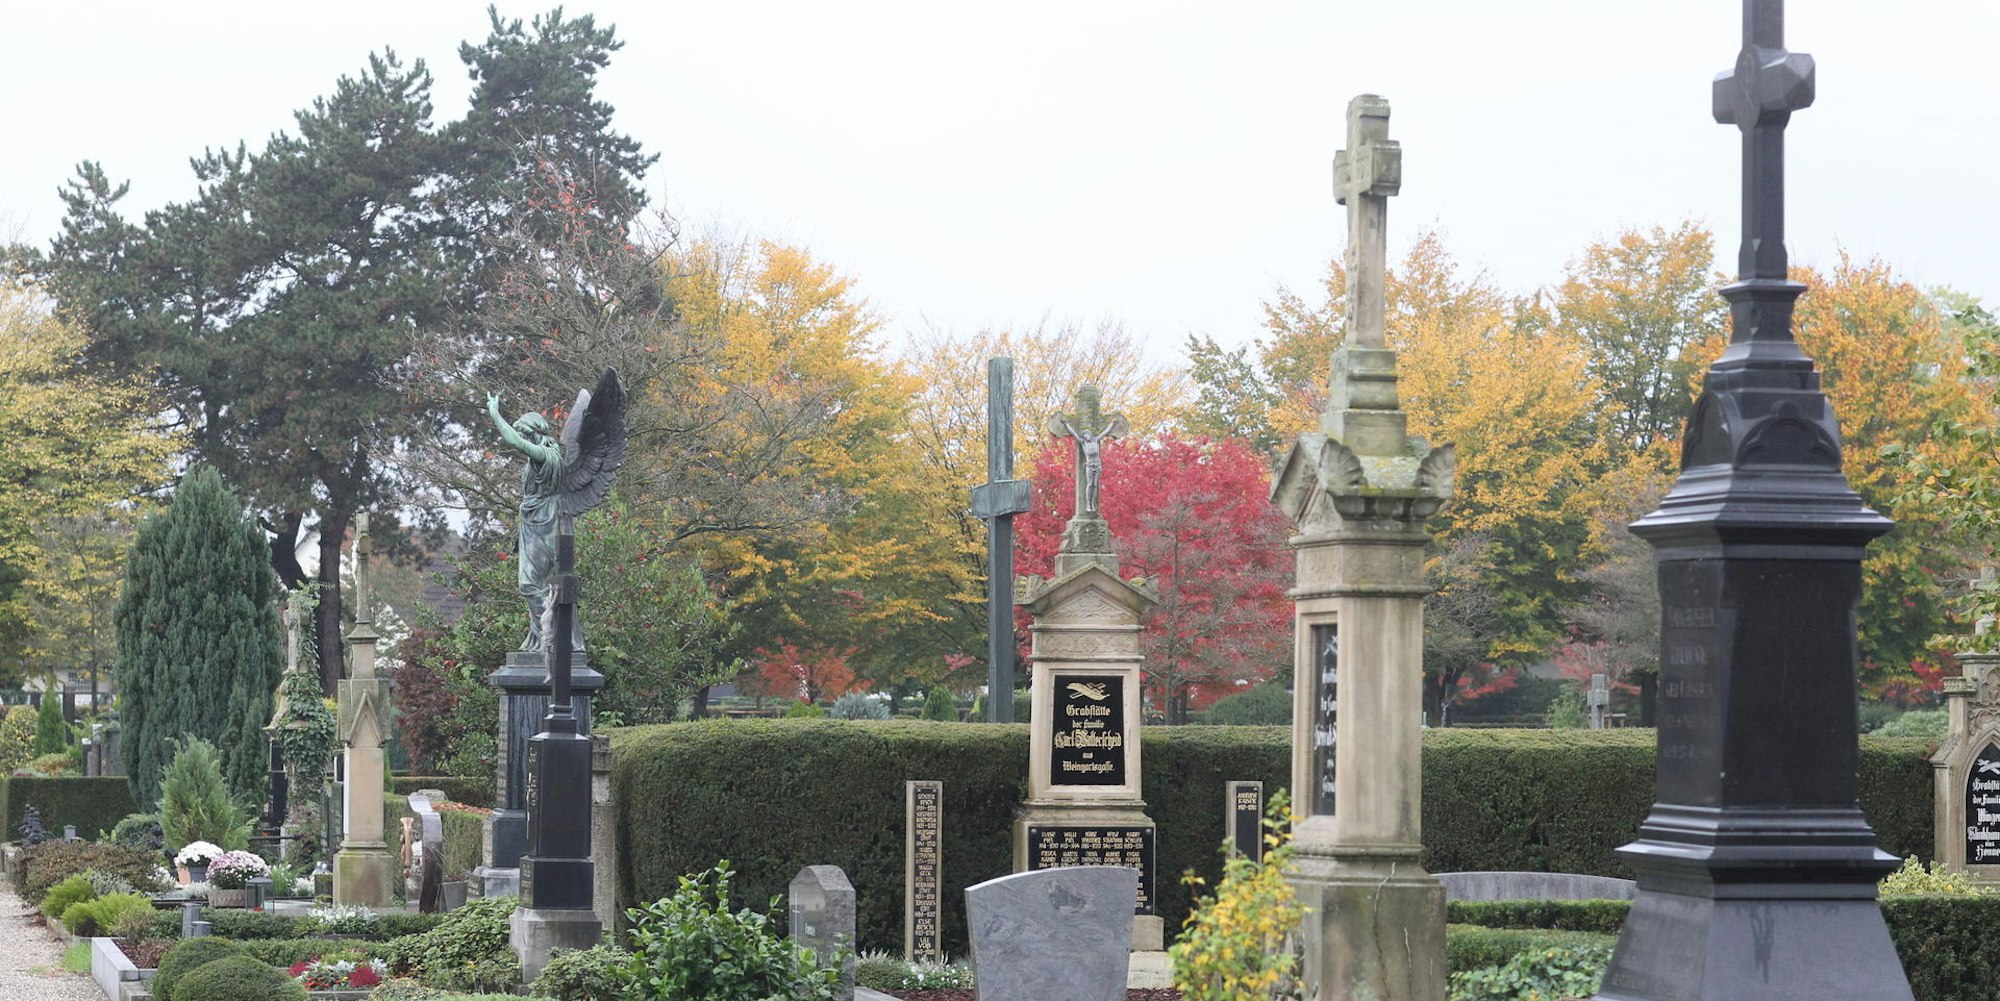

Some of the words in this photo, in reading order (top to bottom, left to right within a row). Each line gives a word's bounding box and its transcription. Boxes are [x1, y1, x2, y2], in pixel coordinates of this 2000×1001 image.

[1066, 704, 1111, 718] Grabstätte
[1072, 720, 1083, 729] der
[1972, 794, 1982, 804] der
